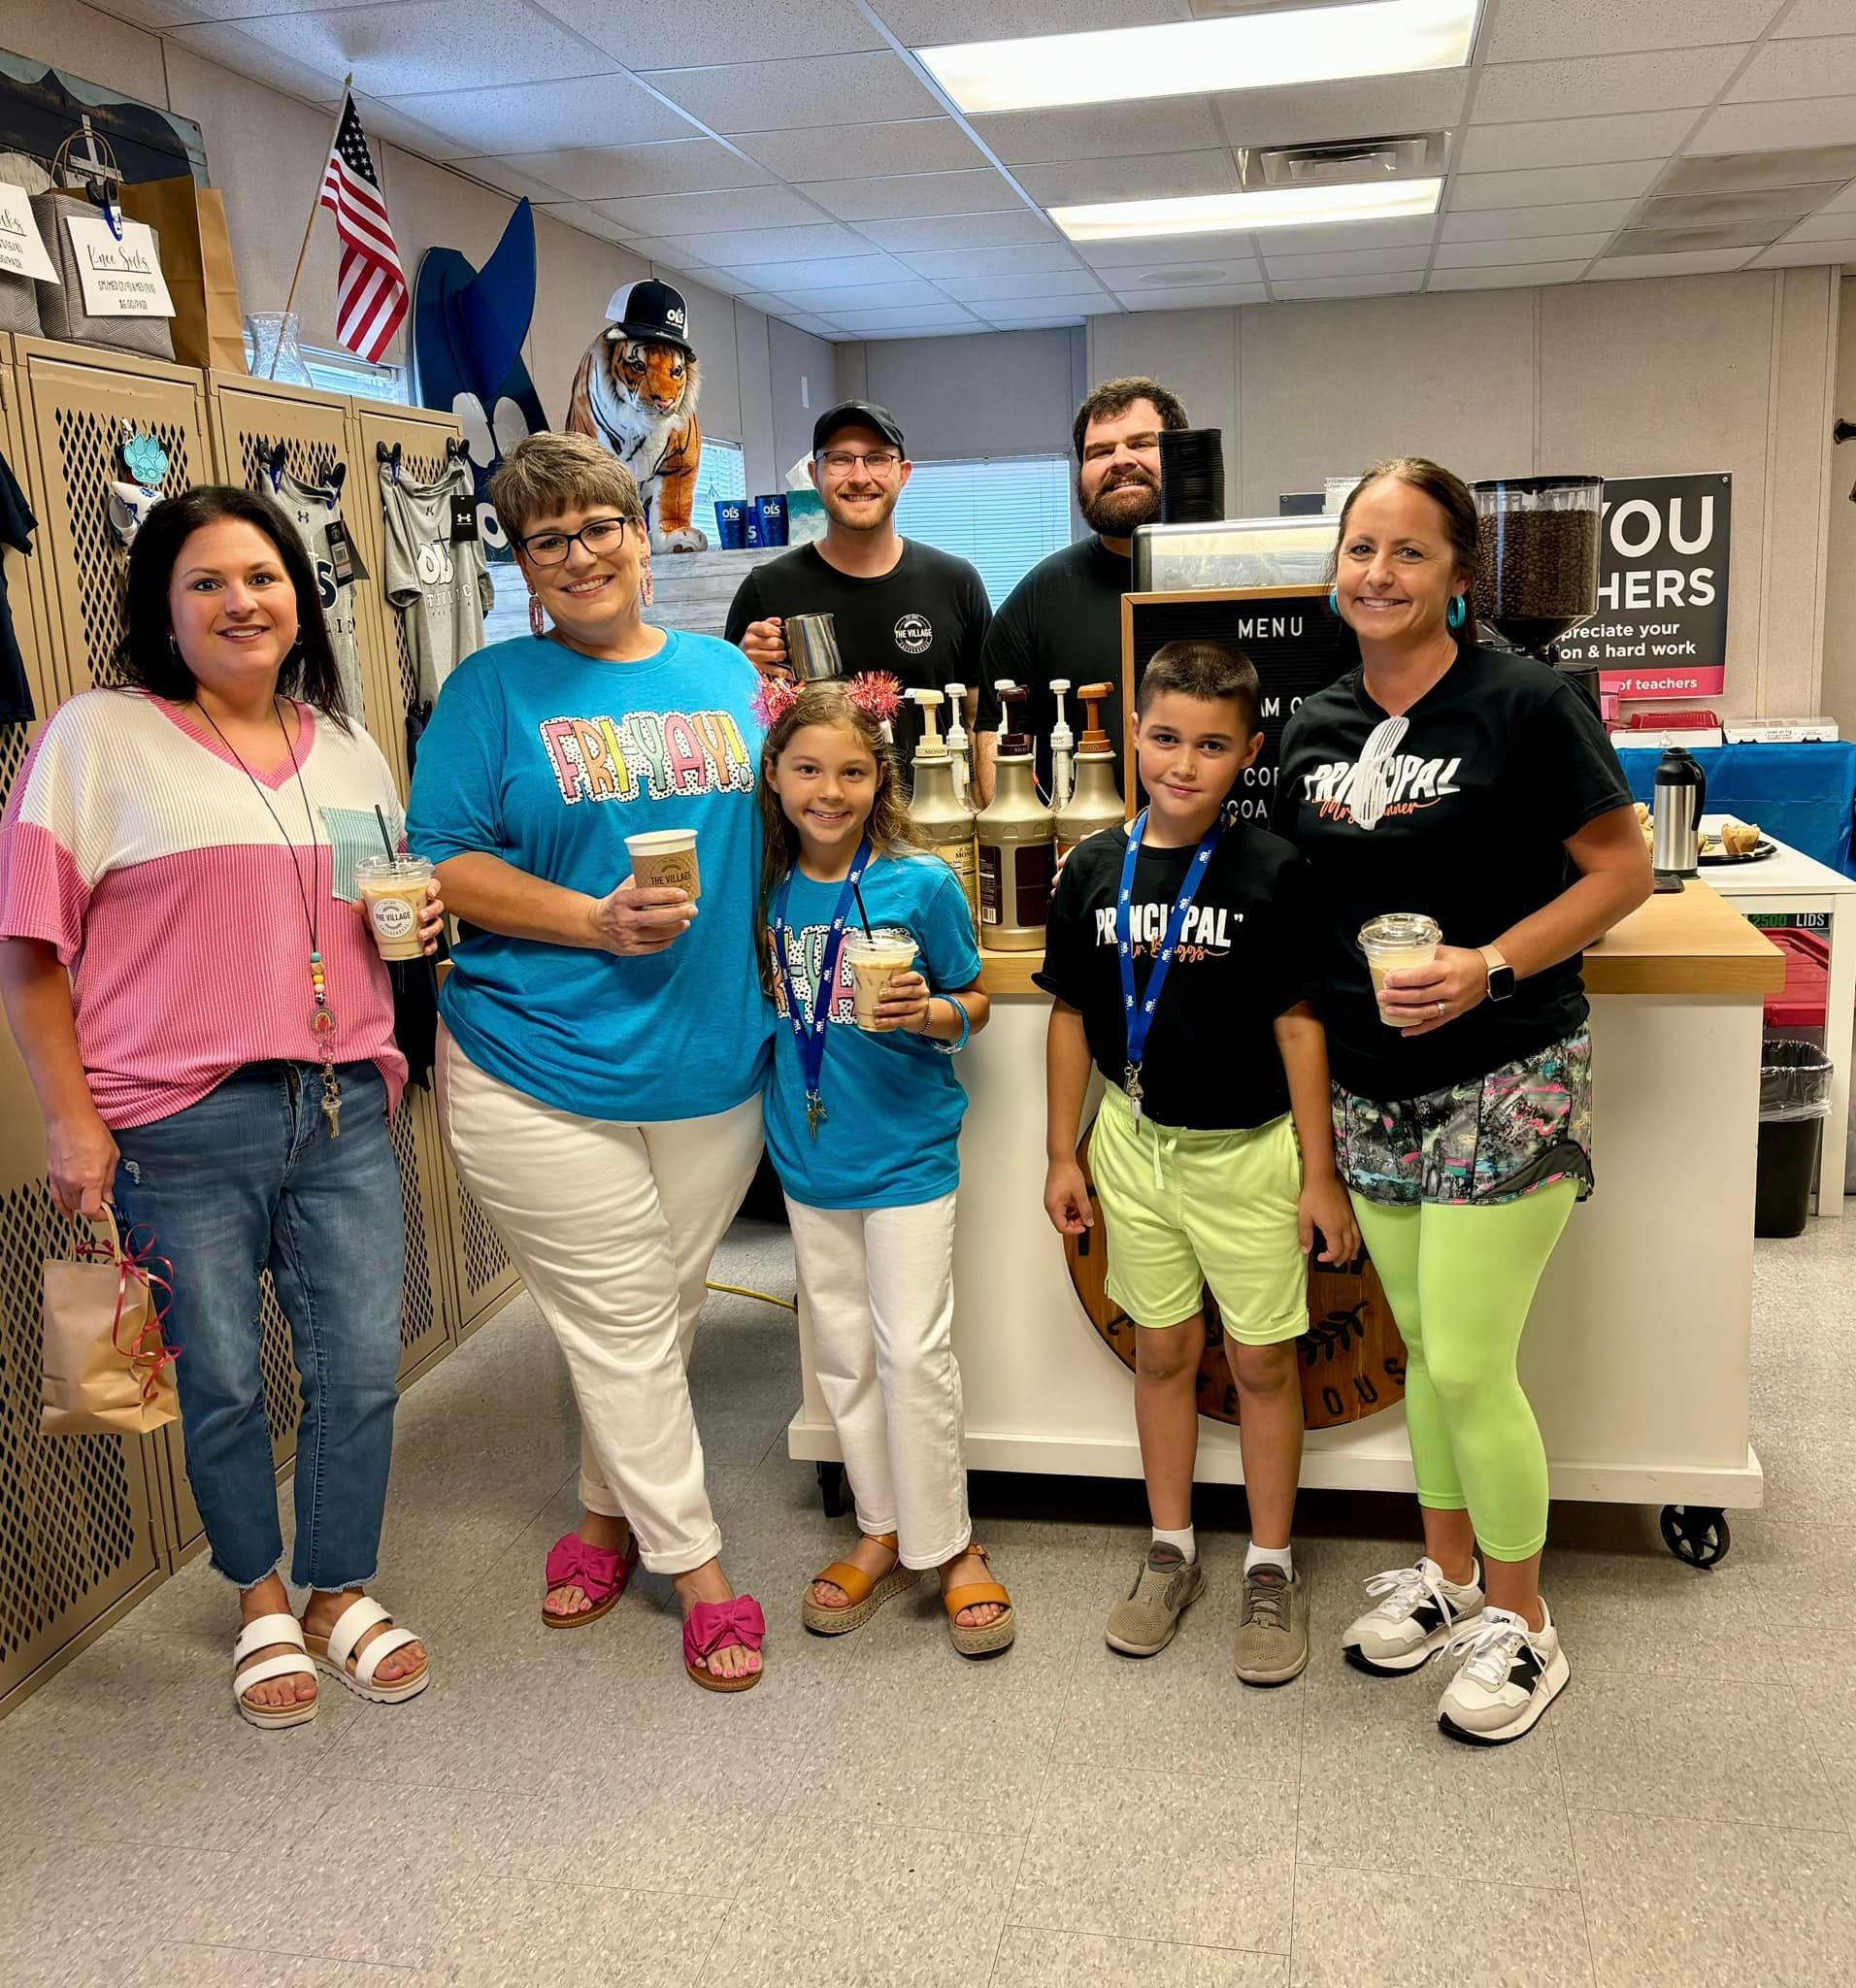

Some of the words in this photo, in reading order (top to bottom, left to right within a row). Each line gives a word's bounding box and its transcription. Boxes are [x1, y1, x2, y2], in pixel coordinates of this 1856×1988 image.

[722, 506, 740, 518] OLS
[763, 502, 780, 514] OLS
[895, 629, 907, 639] THE
[907, 628, 932, 638] VILLAGE
[1238, 616, 1303, 640] MENU
[1639, 622, 1680, 639] your
[1587, 645, 1600, 658] &
[1606, 644, 1645, 658] hard
[1651, 641, 1697, 656] work
[1636, 678, 1698, 691] teachers
[541, 712, 753, 803] FRI-YAY!
[651, 877, 665, 885] THE
[385, 911, 411, 921] VILLAGE
[1796, 913, 1825, 927] LIDS
